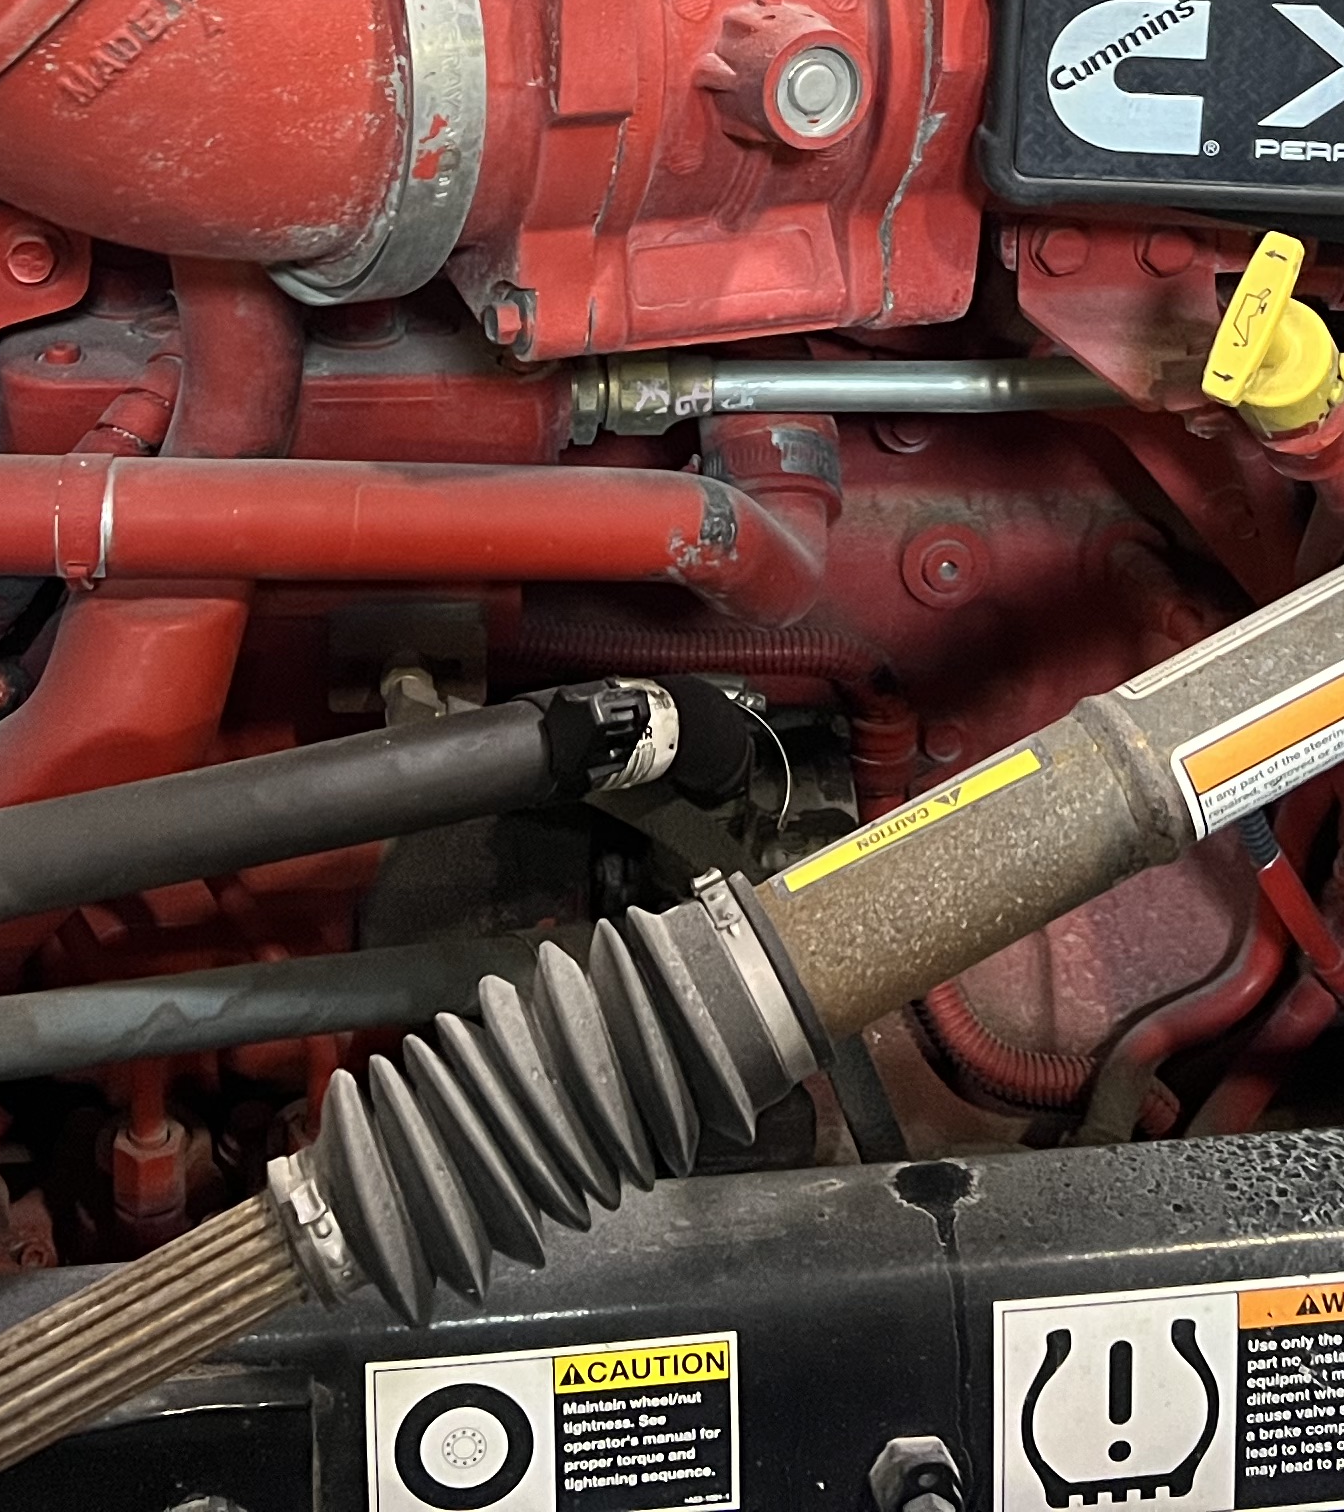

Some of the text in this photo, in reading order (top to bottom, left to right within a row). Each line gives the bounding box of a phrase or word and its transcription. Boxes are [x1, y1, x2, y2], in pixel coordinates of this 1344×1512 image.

[1214, 784, 1239, 804] any
[1237, 769, 1266, 791] part
[1279, 749, 1302, 767] the
[856, 807, 930, 852] CAUTION
[1248, 1338, 1276, 1353] Use
[1281, 1336, 1313, 1351] only
[1318, 1333, 1342, 1346] the
[587, 1350, 725, 1383] CAUTION
[1248, 1355, 1277, 1373] part
[1247, 1369, 1329, 1389] equipmet
[563, 1391, 702, 1416] Maintain wheel/nut
[1247, 1389, 1310, 1406] different
[564, 1413, 666, 1435] tightness. See
[1246, 1408, 1291, 1424] cause
[1296, 1405, 1335, 1420] valve
[564, 1426, 721, 1454] operator's manual for
[1246, 1430, 1255, 1441] a
[1259, 1426, 1301, 1441] brake
[1246, 1444, 1277, 1459] lead
[1281, 1443, 1296, 1456] to
[1300, 1440, 1332, 1454] loss
[564, 1448, 695, 1474] proper torque and
[1246, 1462, 1276, 1477] may
[1281, 1458, 1312, 1474] lead
[1317, 1457, 1332, 1470] to
[564, 1467, 716, 1491] tightening sequence.
